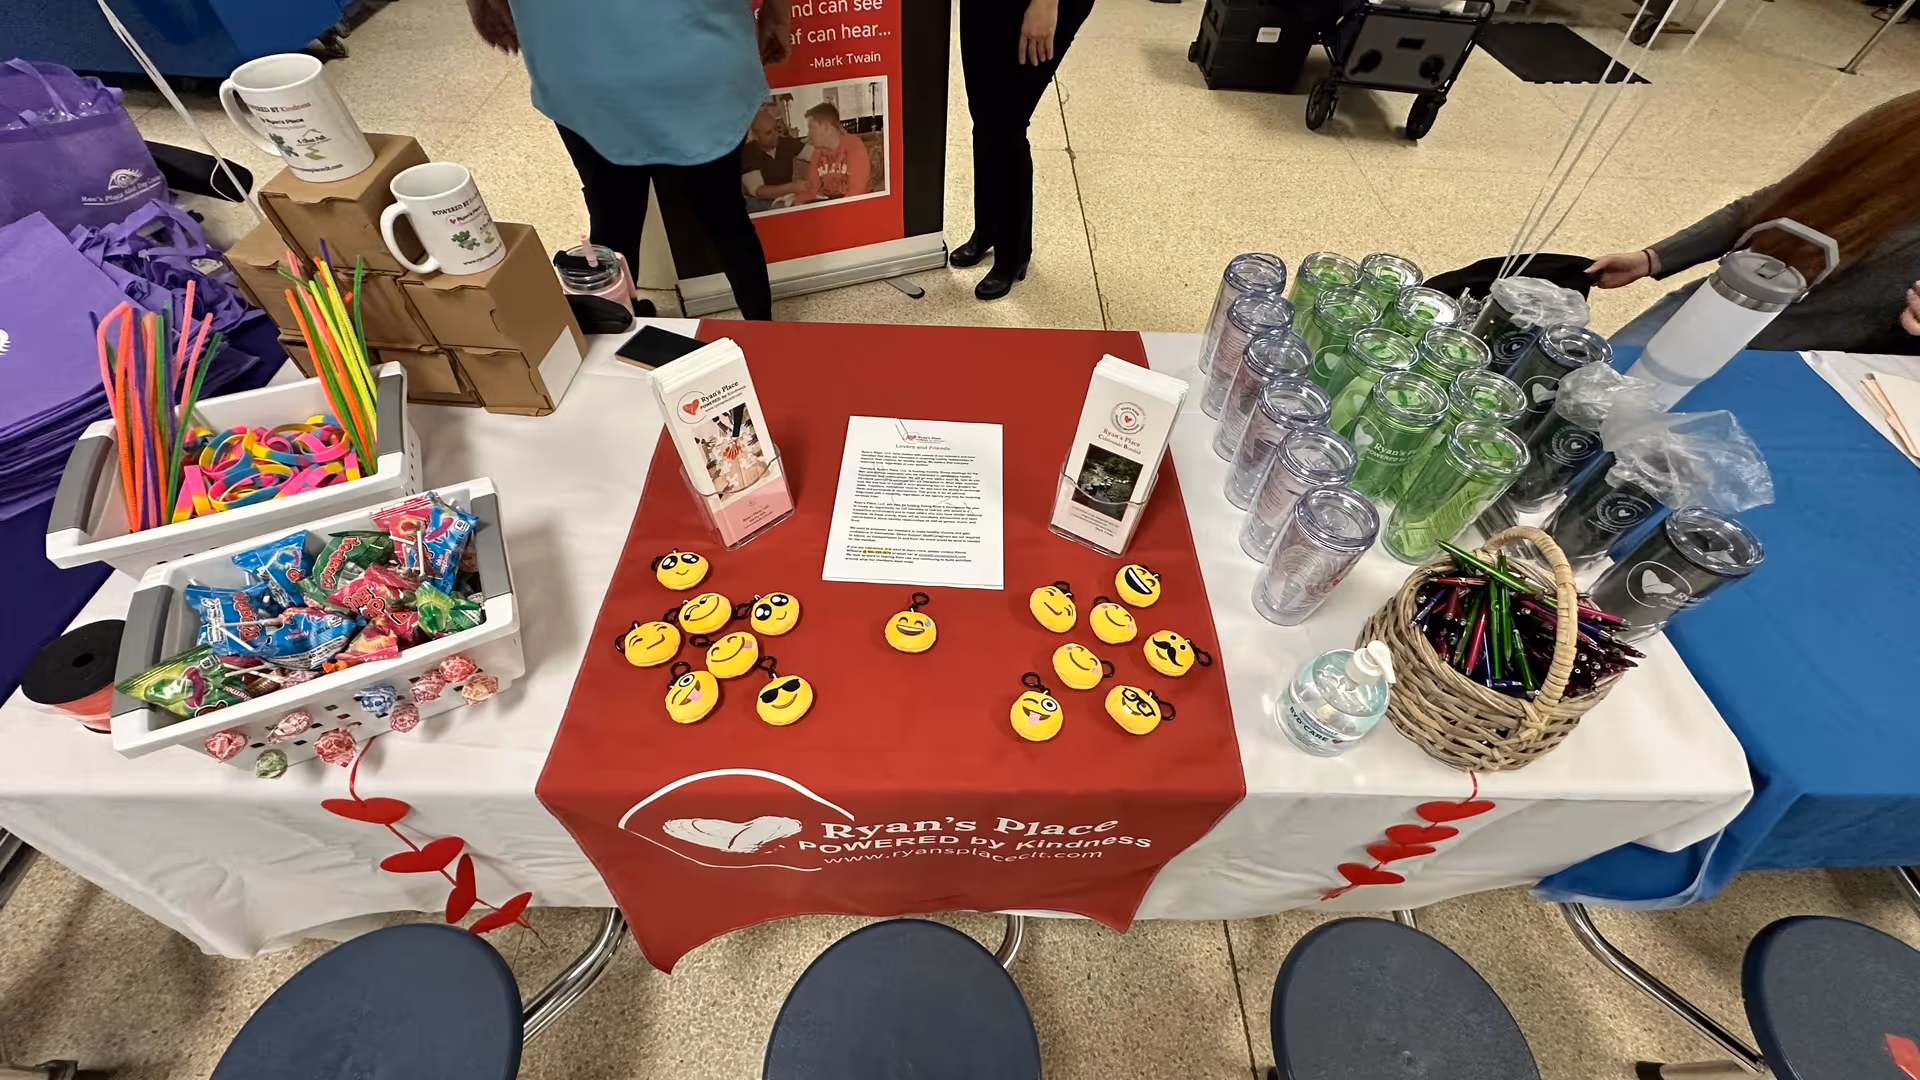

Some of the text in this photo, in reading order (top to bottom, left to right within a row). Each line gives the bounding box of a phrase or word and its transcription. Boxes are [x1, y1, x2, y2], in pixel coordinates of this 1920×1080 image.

[819, 0, 849, 14] can
[853, 0, 883, 11] see
[807, 28, 837, 43] can
[841, 23, 891, 39] hear...
[810, 50, 882, 69] -Mark Twain
[431, 203, 463, 216] POWERED
[700, 381, 738, 403] Ryan's Place
[1103, 428, 1141, 448] Ryan's Place
[1374, 442, 1406, 457] Ryan's
[342, 584, 376, 613] ing
[1303, 725, 1330, 742] CARE
[820, 816, 1119, 839] Ryan's Place
[798, 835, 1152, 854] POWERED by Kindness
